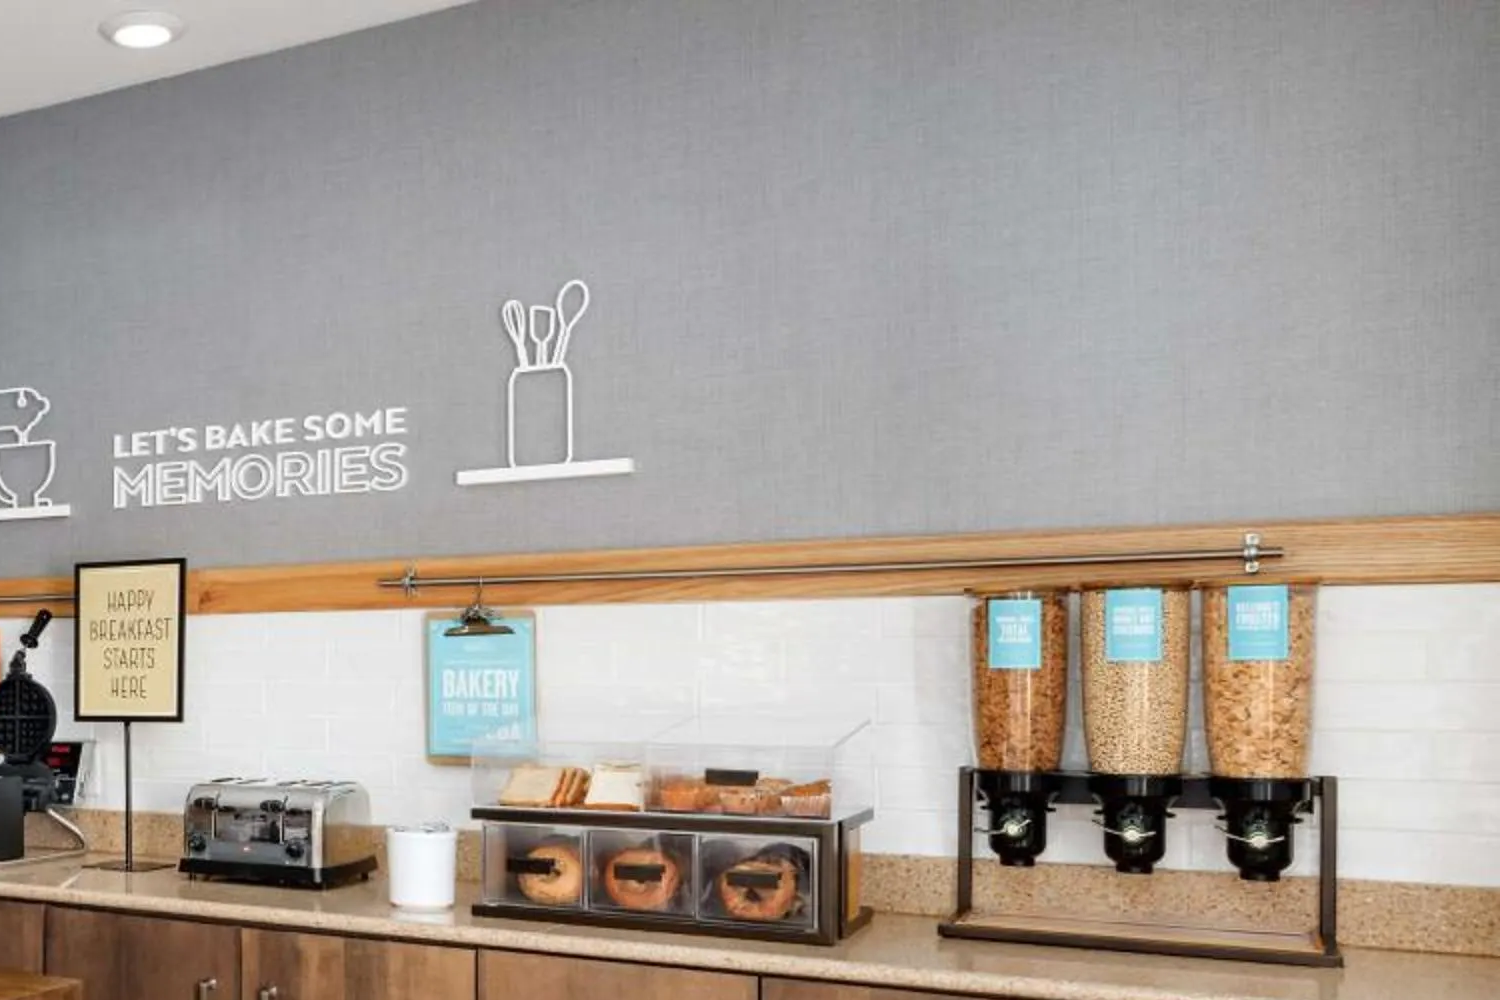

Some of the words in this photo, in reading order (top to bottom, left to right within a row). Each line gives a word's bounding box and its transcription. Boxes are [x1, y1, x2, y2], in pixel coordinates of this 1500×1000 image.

[113, 427, 197, 458] LET'S
[205, 417, 296, 450] BAKE
[303, 407, 408, 441] SOME
[112, 442, 408, 508] MEMORIES
[107, 589, 155, 612] HAPPY
[89, 617, 173, 641] BREAKFAST
[102, 647, 156, 670] STARTS
[111, 675, 148, 699] HERE
[442, 668, 519, 699] BAKERY
